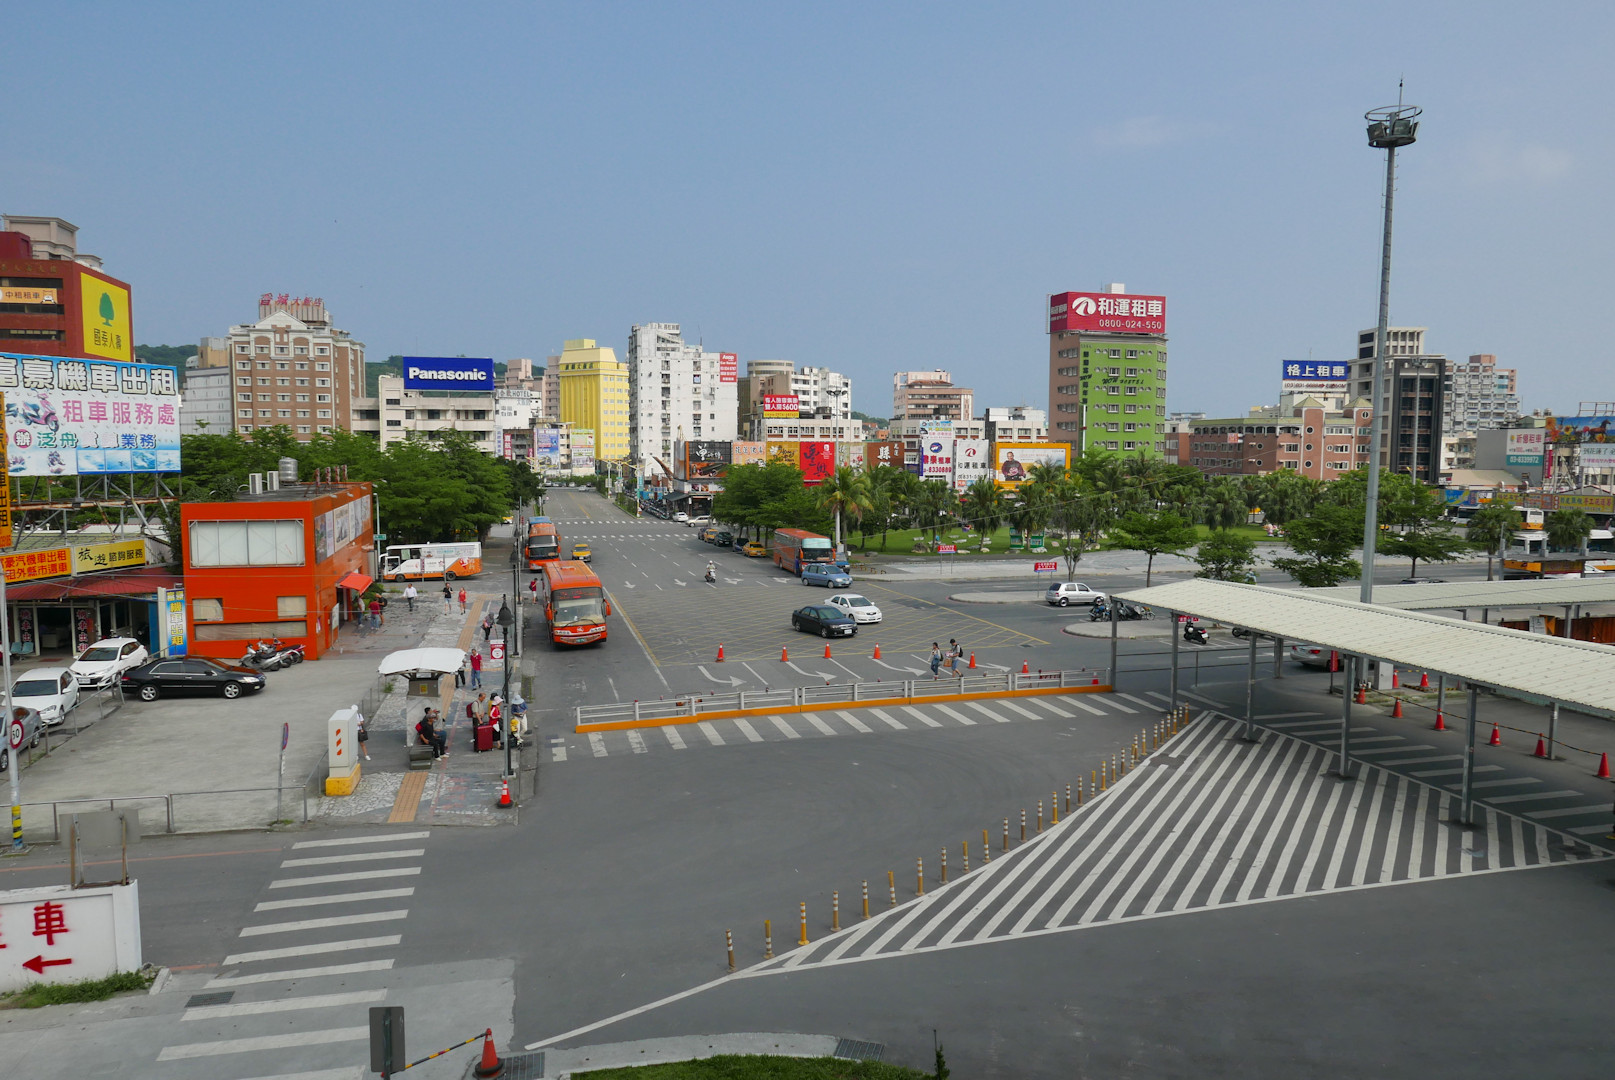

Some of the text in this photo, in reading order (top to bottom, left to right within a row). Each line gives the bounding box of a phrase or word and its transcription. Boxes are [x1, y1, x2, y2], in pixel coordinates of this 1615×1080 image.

[5, 291, 40, 299] 中租租車
[1098, 297, 1163, 318] 和運租車
[1099, 319, 1162, 329] 0800-024-550
[93, 328, 122, 351] 國泰人壽
[0, 356, 176, 396] 富豪機車出租
[408, 366, 487, 381] Panasonic
[1286, 363, 1346, 377] 格上租車
[62, 399, 175, 425] 租車服務處
[15, 432, 31, 447] 辦
[0, 550, 67, 569] 豪汽機車出租
[78, 547, 143, 566] 旅遊諮詢服務
[12, 728, 20, 740] 50
